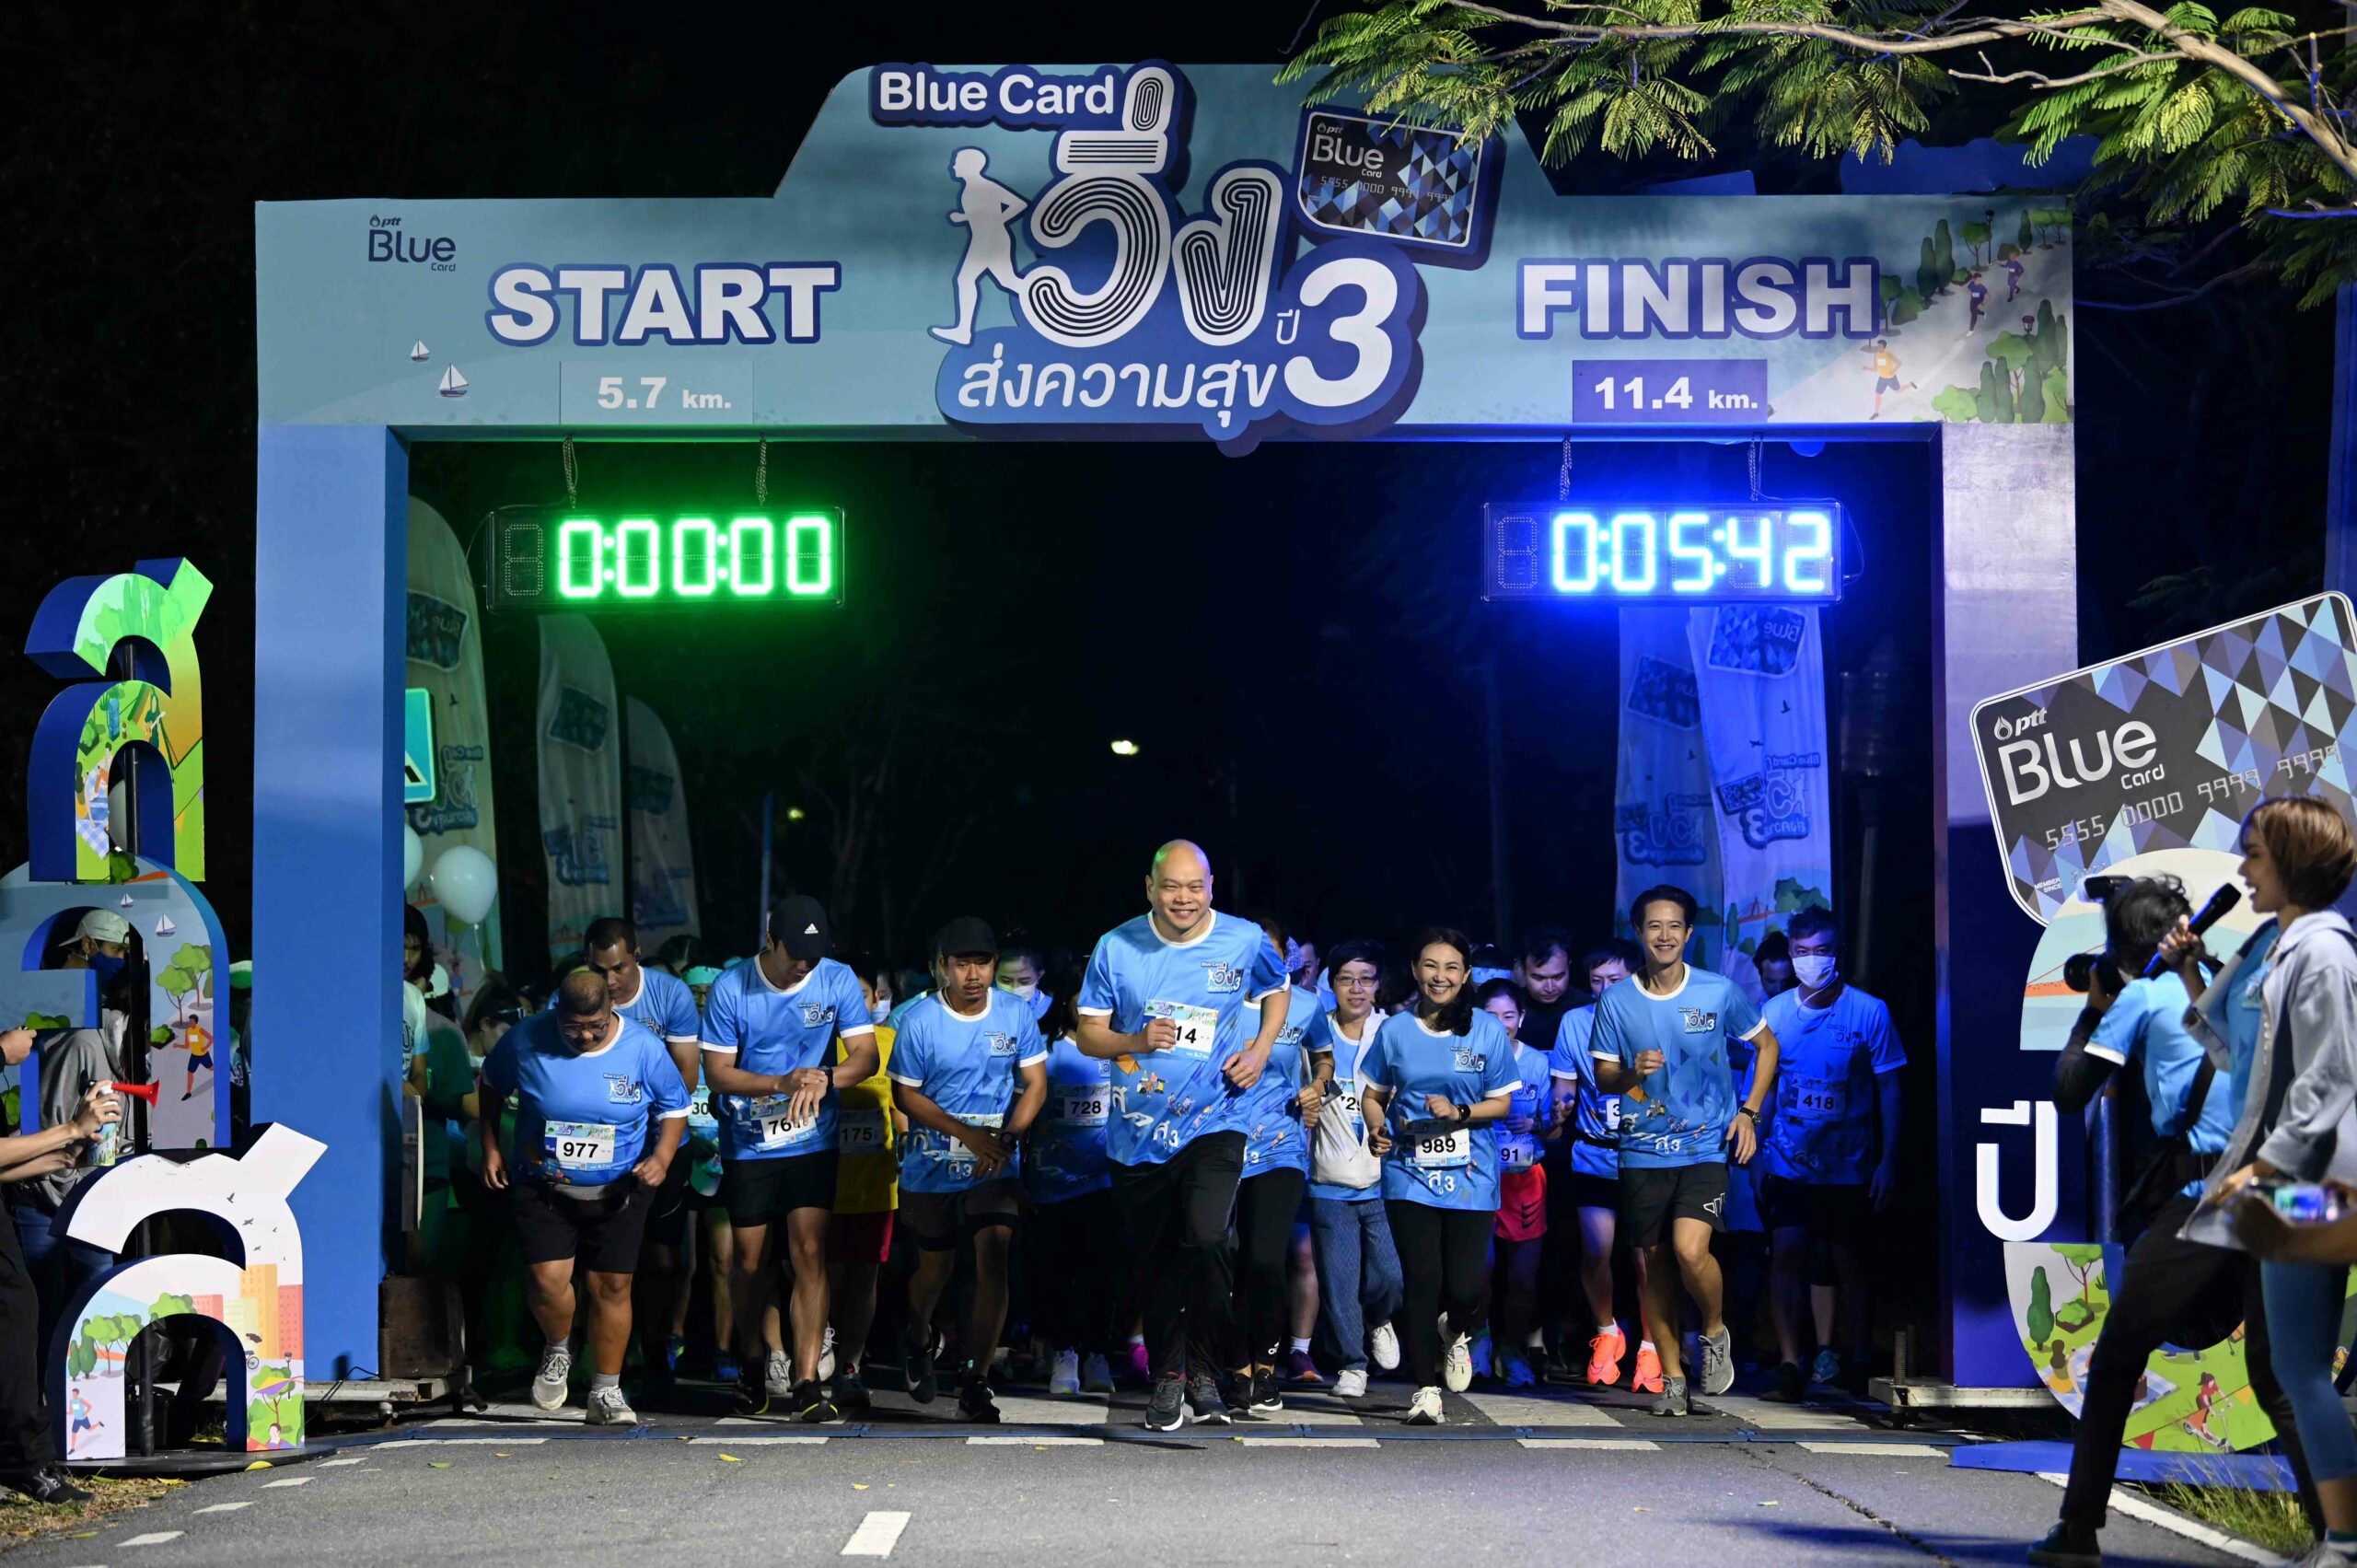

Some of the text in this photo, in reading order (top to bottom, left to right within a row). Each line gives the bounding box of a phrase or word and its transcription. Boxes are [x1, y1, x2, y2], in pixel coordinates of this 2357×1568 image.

[879, 71, 1113, 114] Blue Card
[1312, 134, 1384, 169] Blue
[381, 217, 401, 227] ptt
[368, 229, 457, 262] Blue
[490, 267, 836, 342] START
[1522, 264, 1873, 333] FINISH
[1284, 257, 1398, 407] 3
[597, 377, 732, 410] 5.7 km.
[958, 343, 1278, 428] ส่งความสุข
[1594, 377, 1759, 411] 11.4 km.
[558, 517, 830, 598] 0:00:00
[1552, 512, 1832, 592] 0:05:42
[2014, 707, 2048, 737] ptt
[1998, 720, 2157, 807] Blue
[2045, 741, 2343, 851] 5555 0000 9999 9999
[2034, 877, 2061, 889] MEMBER
[2044, 882, 2063, 893] SINCE
[1071, 1100, 1102, 1115] 728
[1803, 1094, 1834, 1110] 418
[767, 1117, 808, 1135] 76
[841, 1127, 873, 1142] 175
[563, 1142, 598, 1158] 977
[1421, 1138, 1457, 1154] 989
[1498, 1147, 1519, 1162] 91
[1976, 1100, 2058, 1242] ปี
